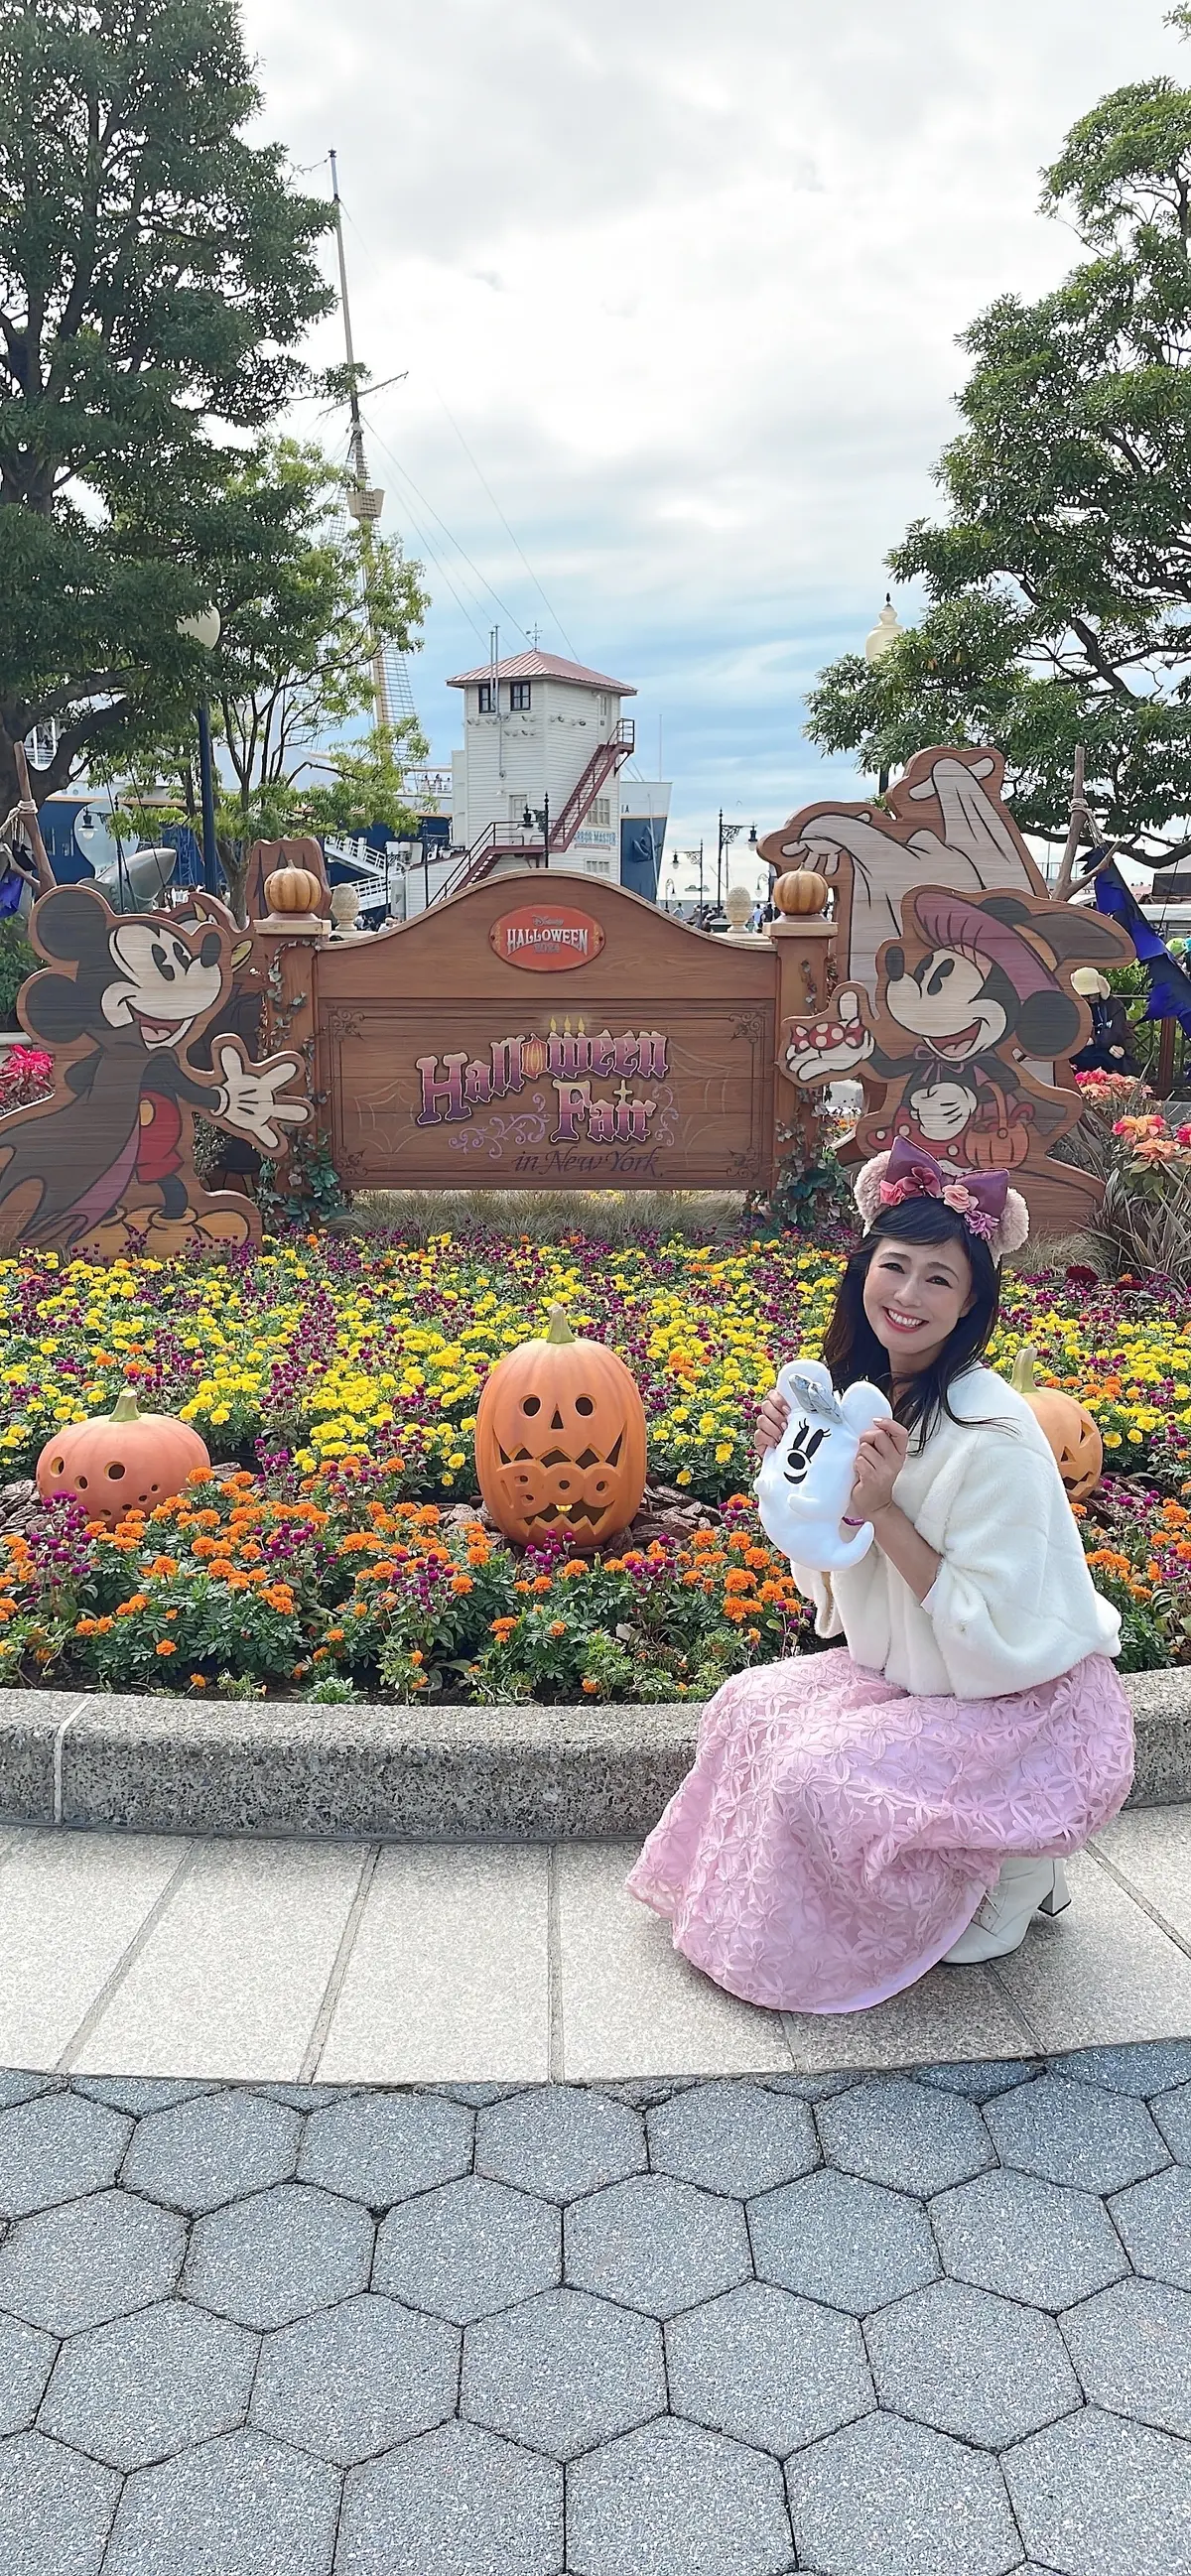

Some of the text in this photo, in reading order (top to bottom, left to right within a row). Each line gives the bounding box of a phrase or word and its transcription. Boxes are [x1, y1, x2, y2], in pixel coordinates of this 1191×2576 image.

[506, 928, 589, 957] HALLOWEEN
[415, 1029, 670, 1125] Halloween
[551, 1079, 657, 1143] Fair
[512, 1151, 539, 1172] in
[539, 1146, 603, 1175] New
